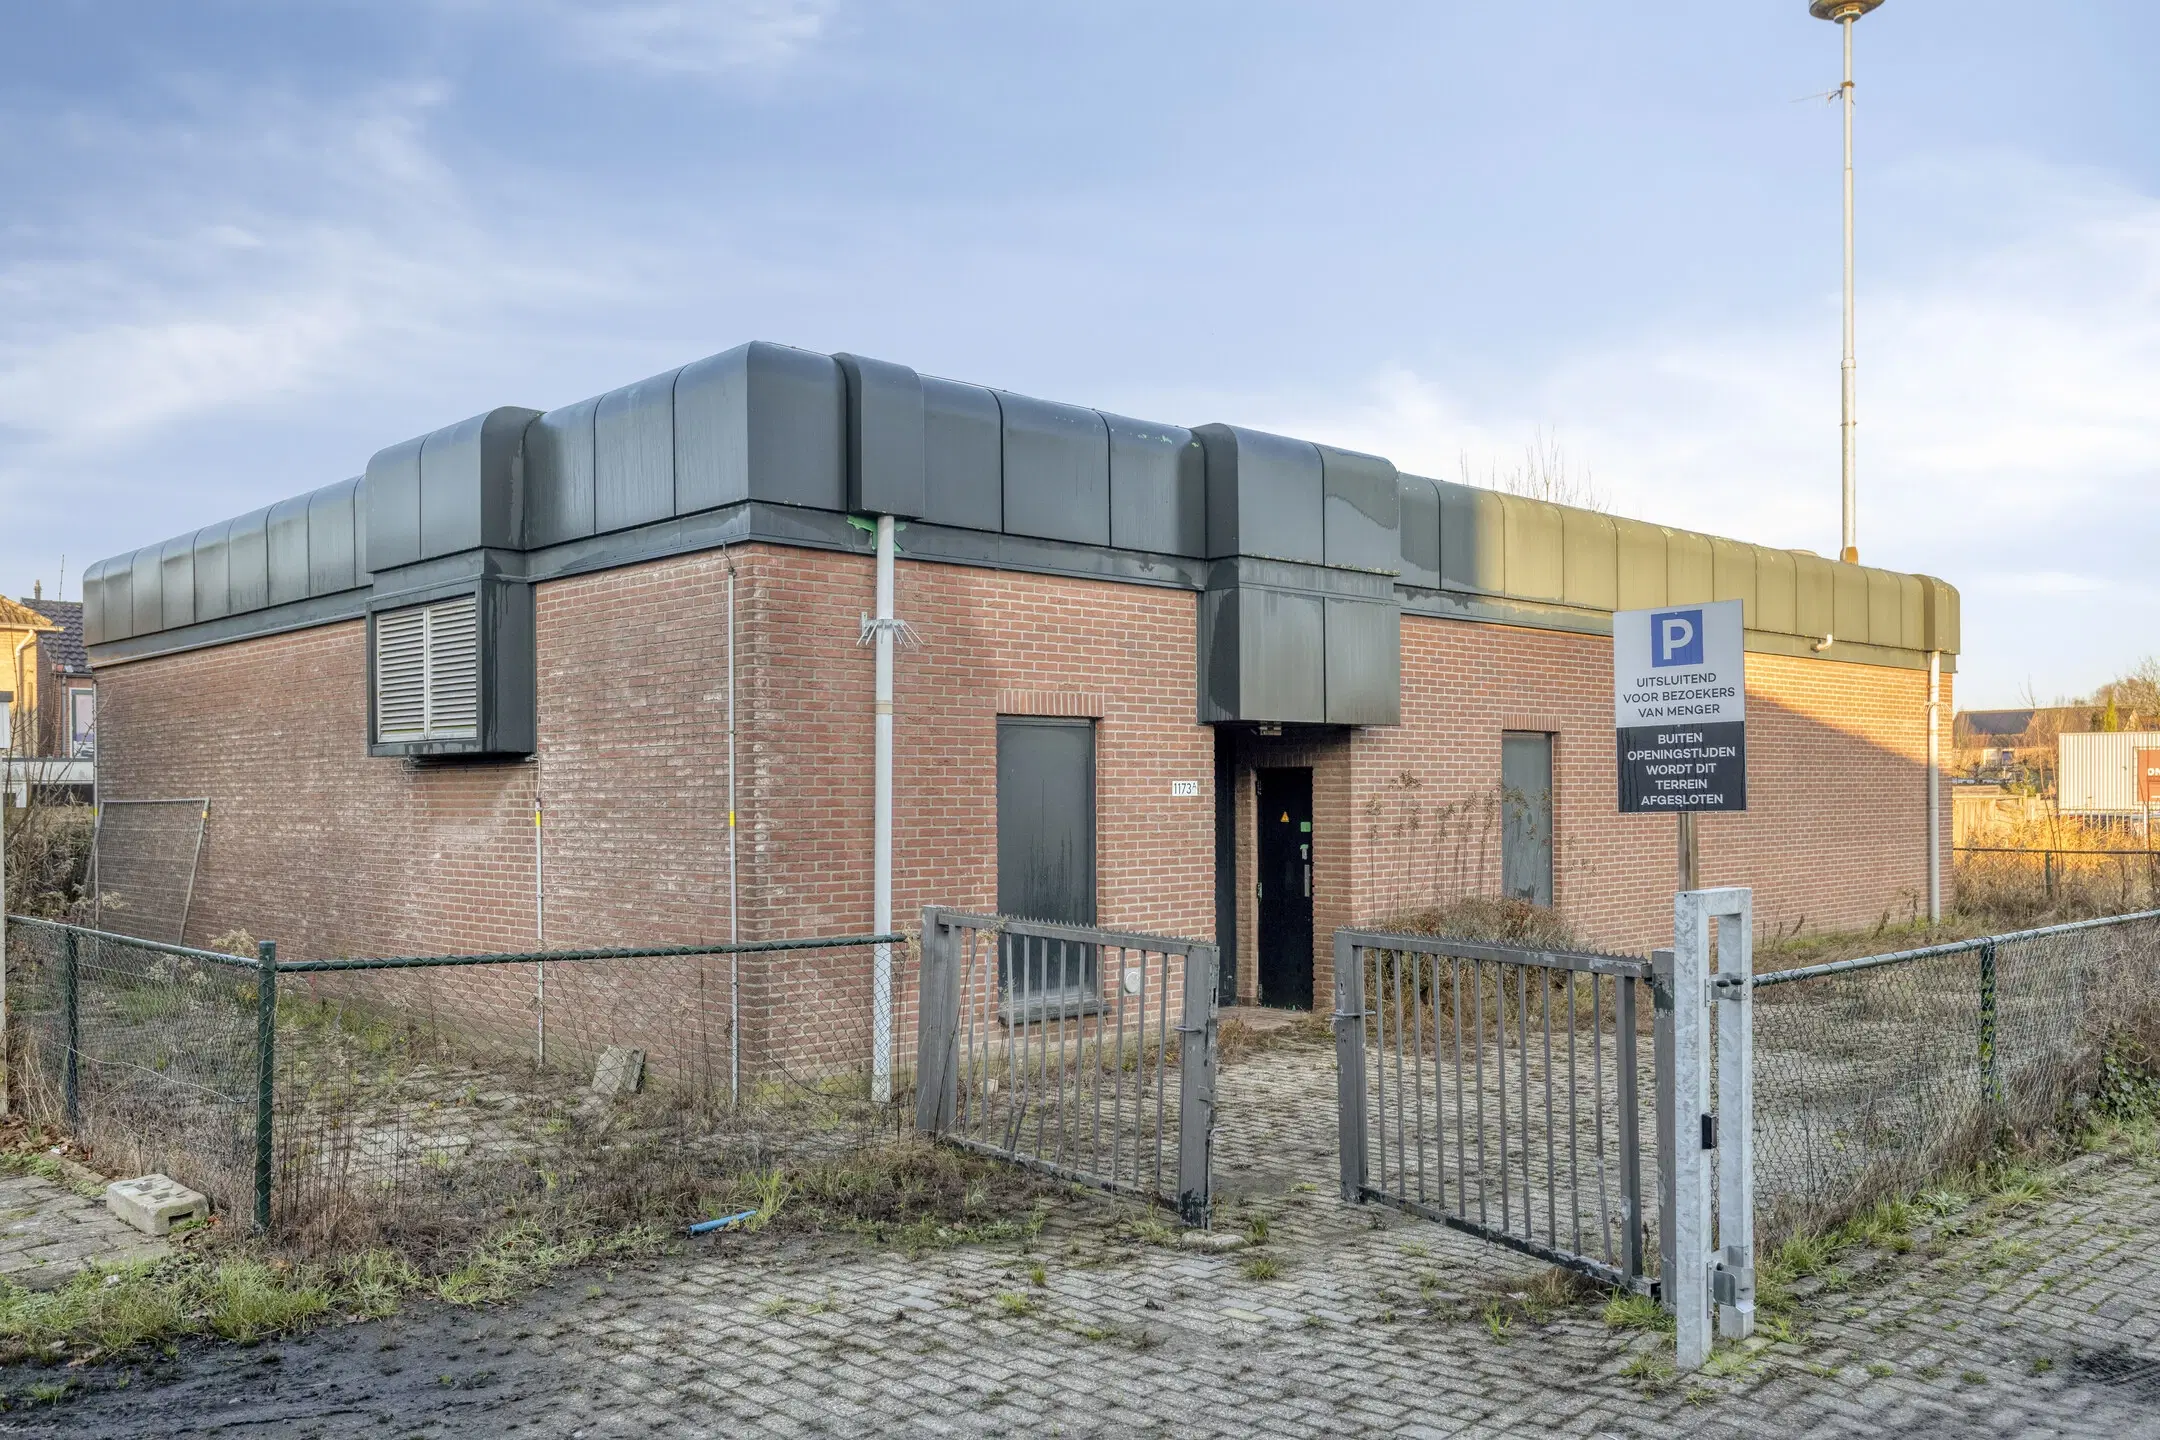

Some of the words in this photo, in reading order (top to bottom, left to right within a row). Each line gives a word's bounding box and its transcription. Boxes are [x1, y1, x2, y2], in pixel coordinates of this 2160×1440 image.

[1662, 618, 1693, 660] P
[1636, 673, 1717, 687] UITSLUITEND
[1623, 692, 1659, 704] VOOR
[1662, 687, 1735, 701] BEZOEKERS
[1638, 708, 1664, 718] VAN
[1667, 703, 1720, 716] MENGER
[1658, 732, 1703, 744] BUITEN
[1627, 747, 1735, 760] OPENINGSTIJDEN
[1645, 764, 1693, 775] WORDT
[1696, 763, 1717, 773] DIT
[1655, 779, 1708, 790] TERREIN
[1641, 794, 1723, 806] AFGESLOTEN
